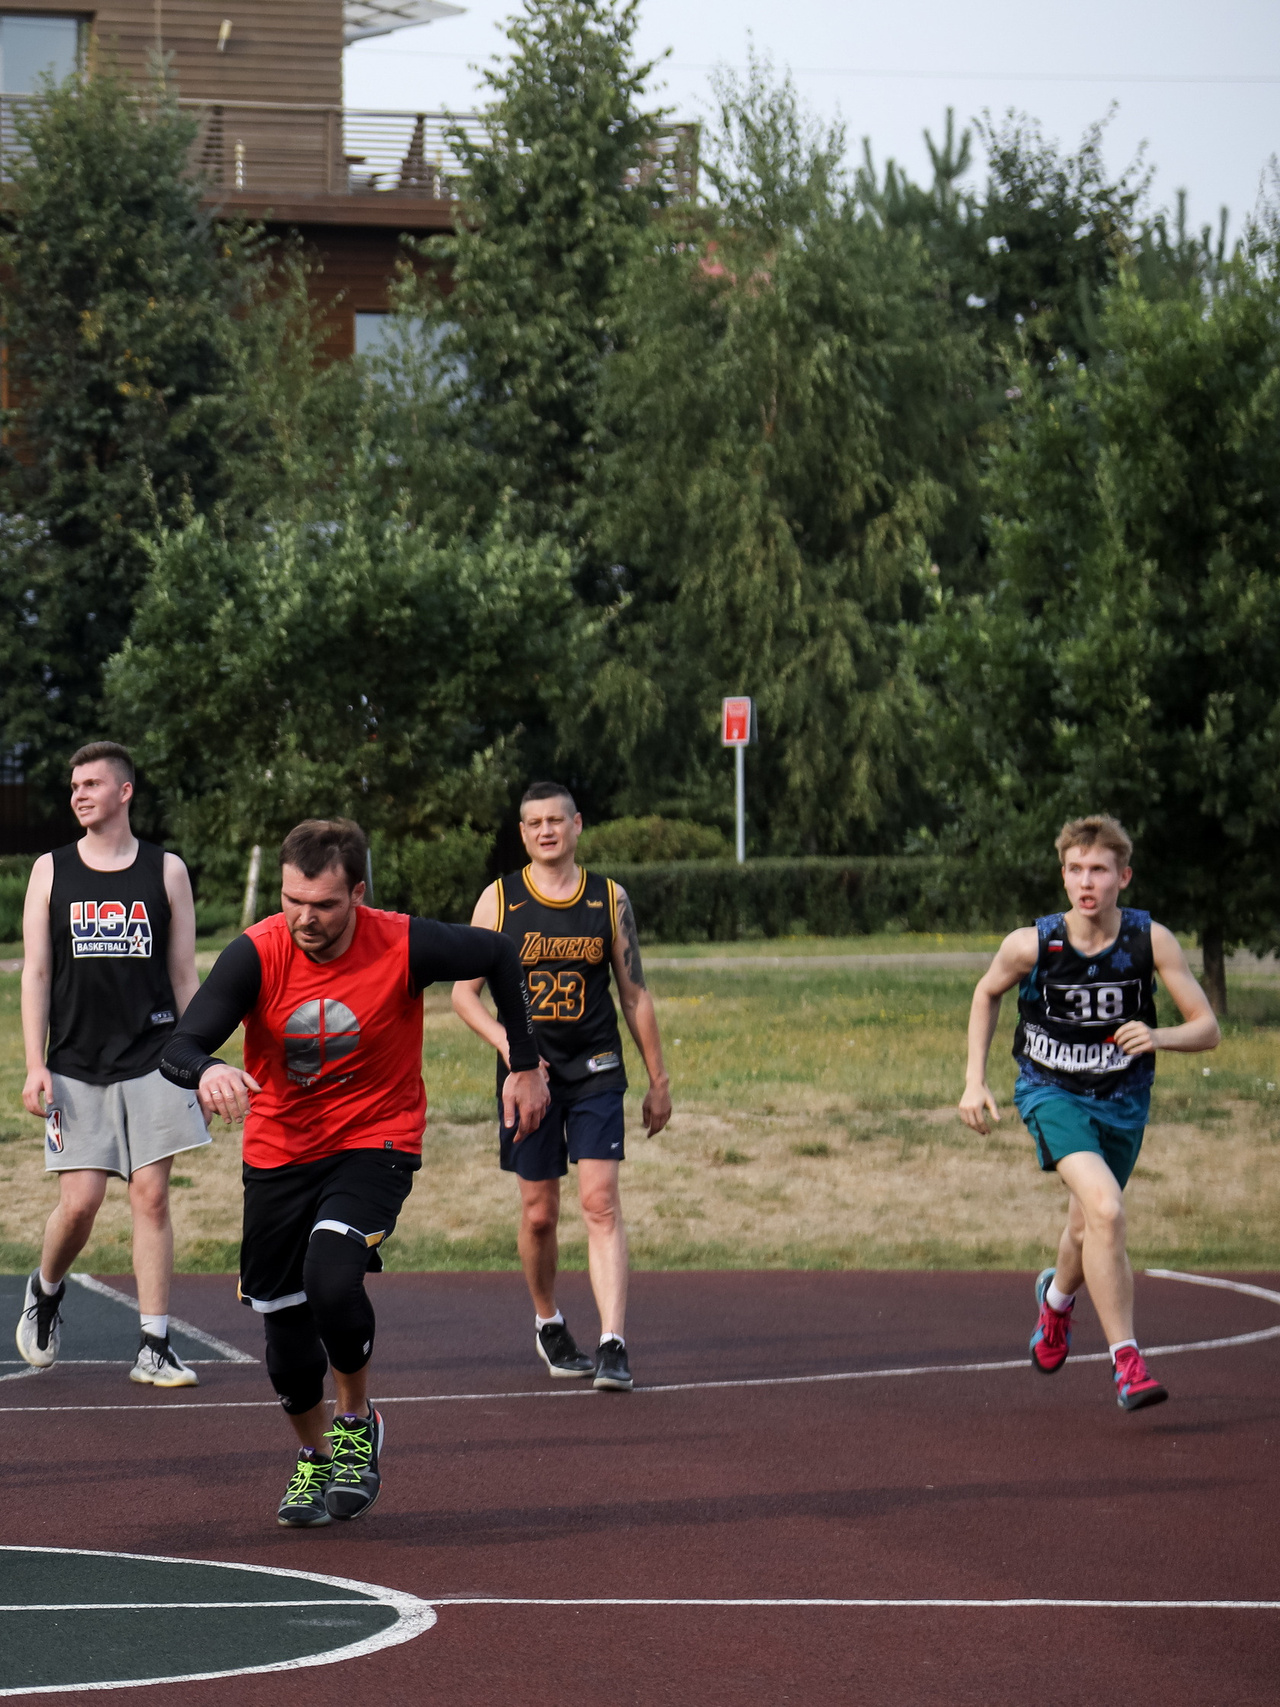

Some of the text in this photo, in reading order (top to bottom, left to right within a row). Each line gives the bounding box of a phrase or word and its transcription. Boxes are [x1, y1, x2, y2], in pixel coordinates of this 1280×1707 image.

[70, 901, 152, 943] USA
[76, 942, 129, 952] BASKETBALL
[519, 932, 604, 965] LAKERS
[528, 970, 586, 1021] 23
[1065, 987, 1123, 1020] 38
